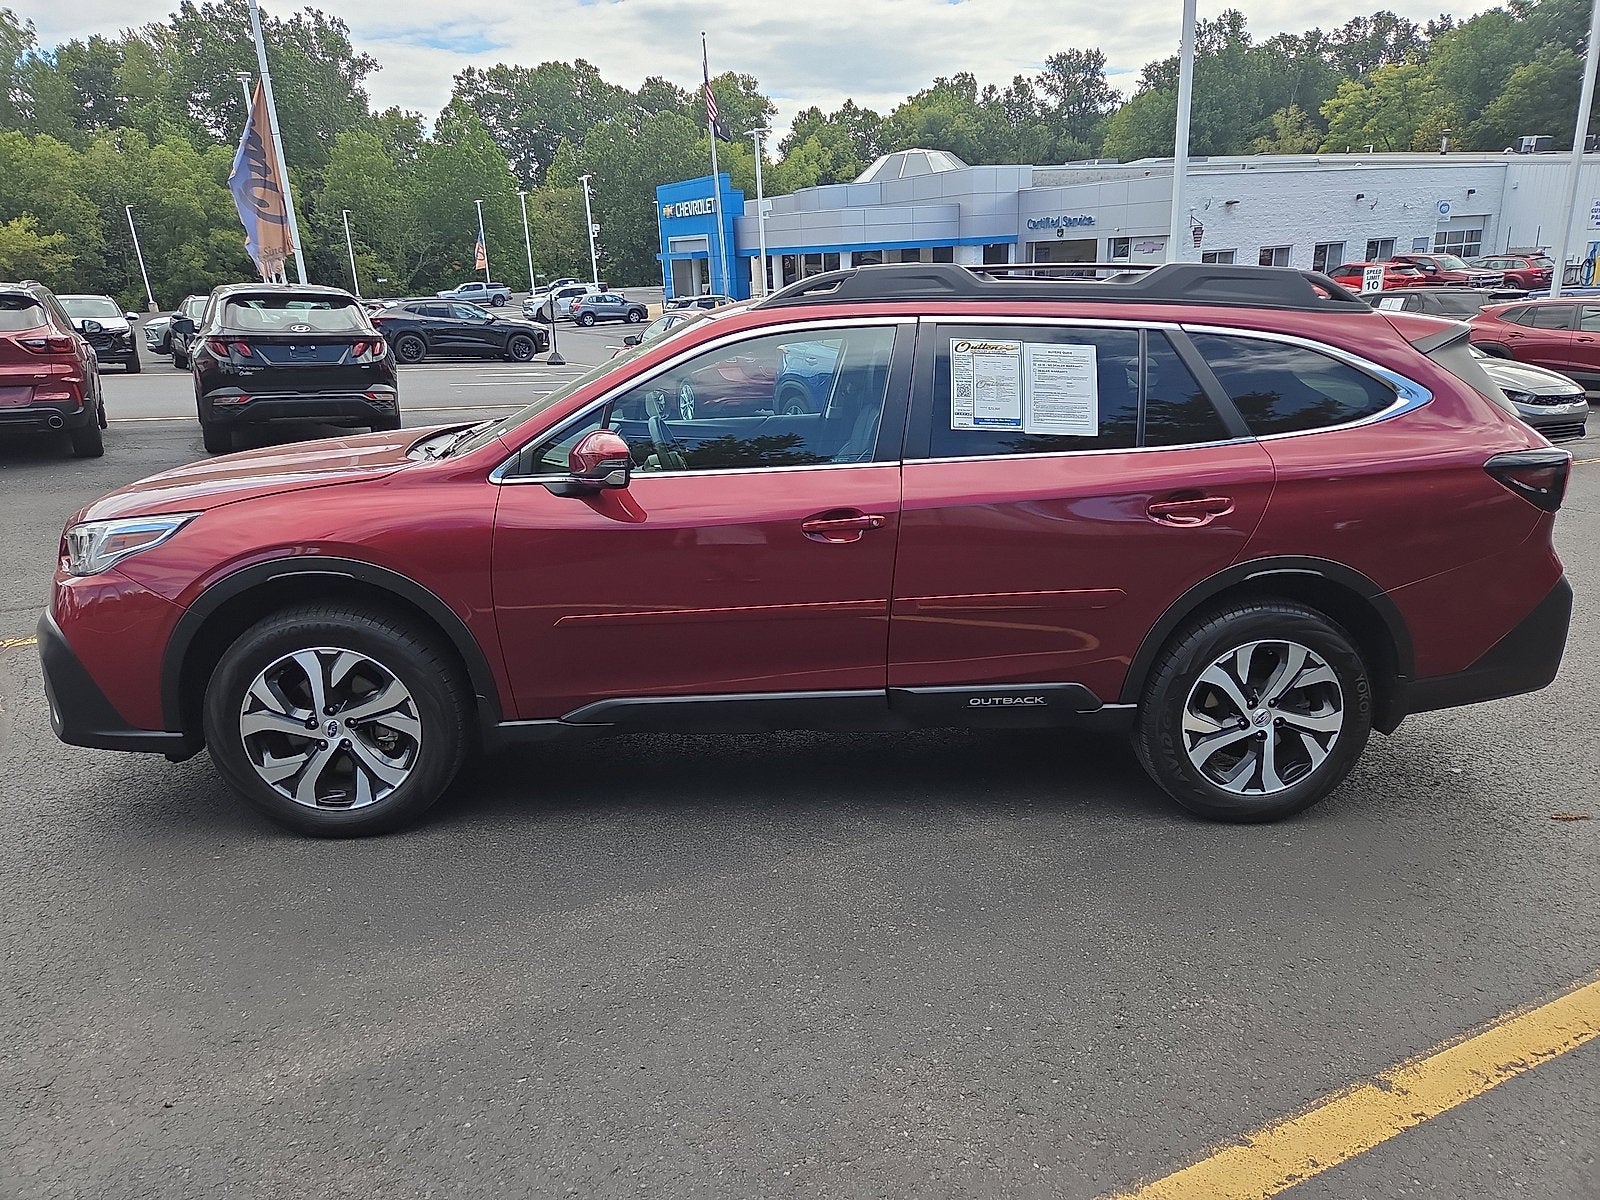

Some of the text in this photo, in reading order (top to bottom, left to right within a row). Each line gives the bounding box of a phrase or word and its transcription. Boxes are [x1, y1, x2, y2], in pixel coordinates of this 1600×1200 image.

[676, 198, 717, 217] CHEVROLET
[1027, 214, 1095, 229] Certified Service
[1366, 281, 1379, 290] 10
[969, 696, 1045, 705] OUTBACK
